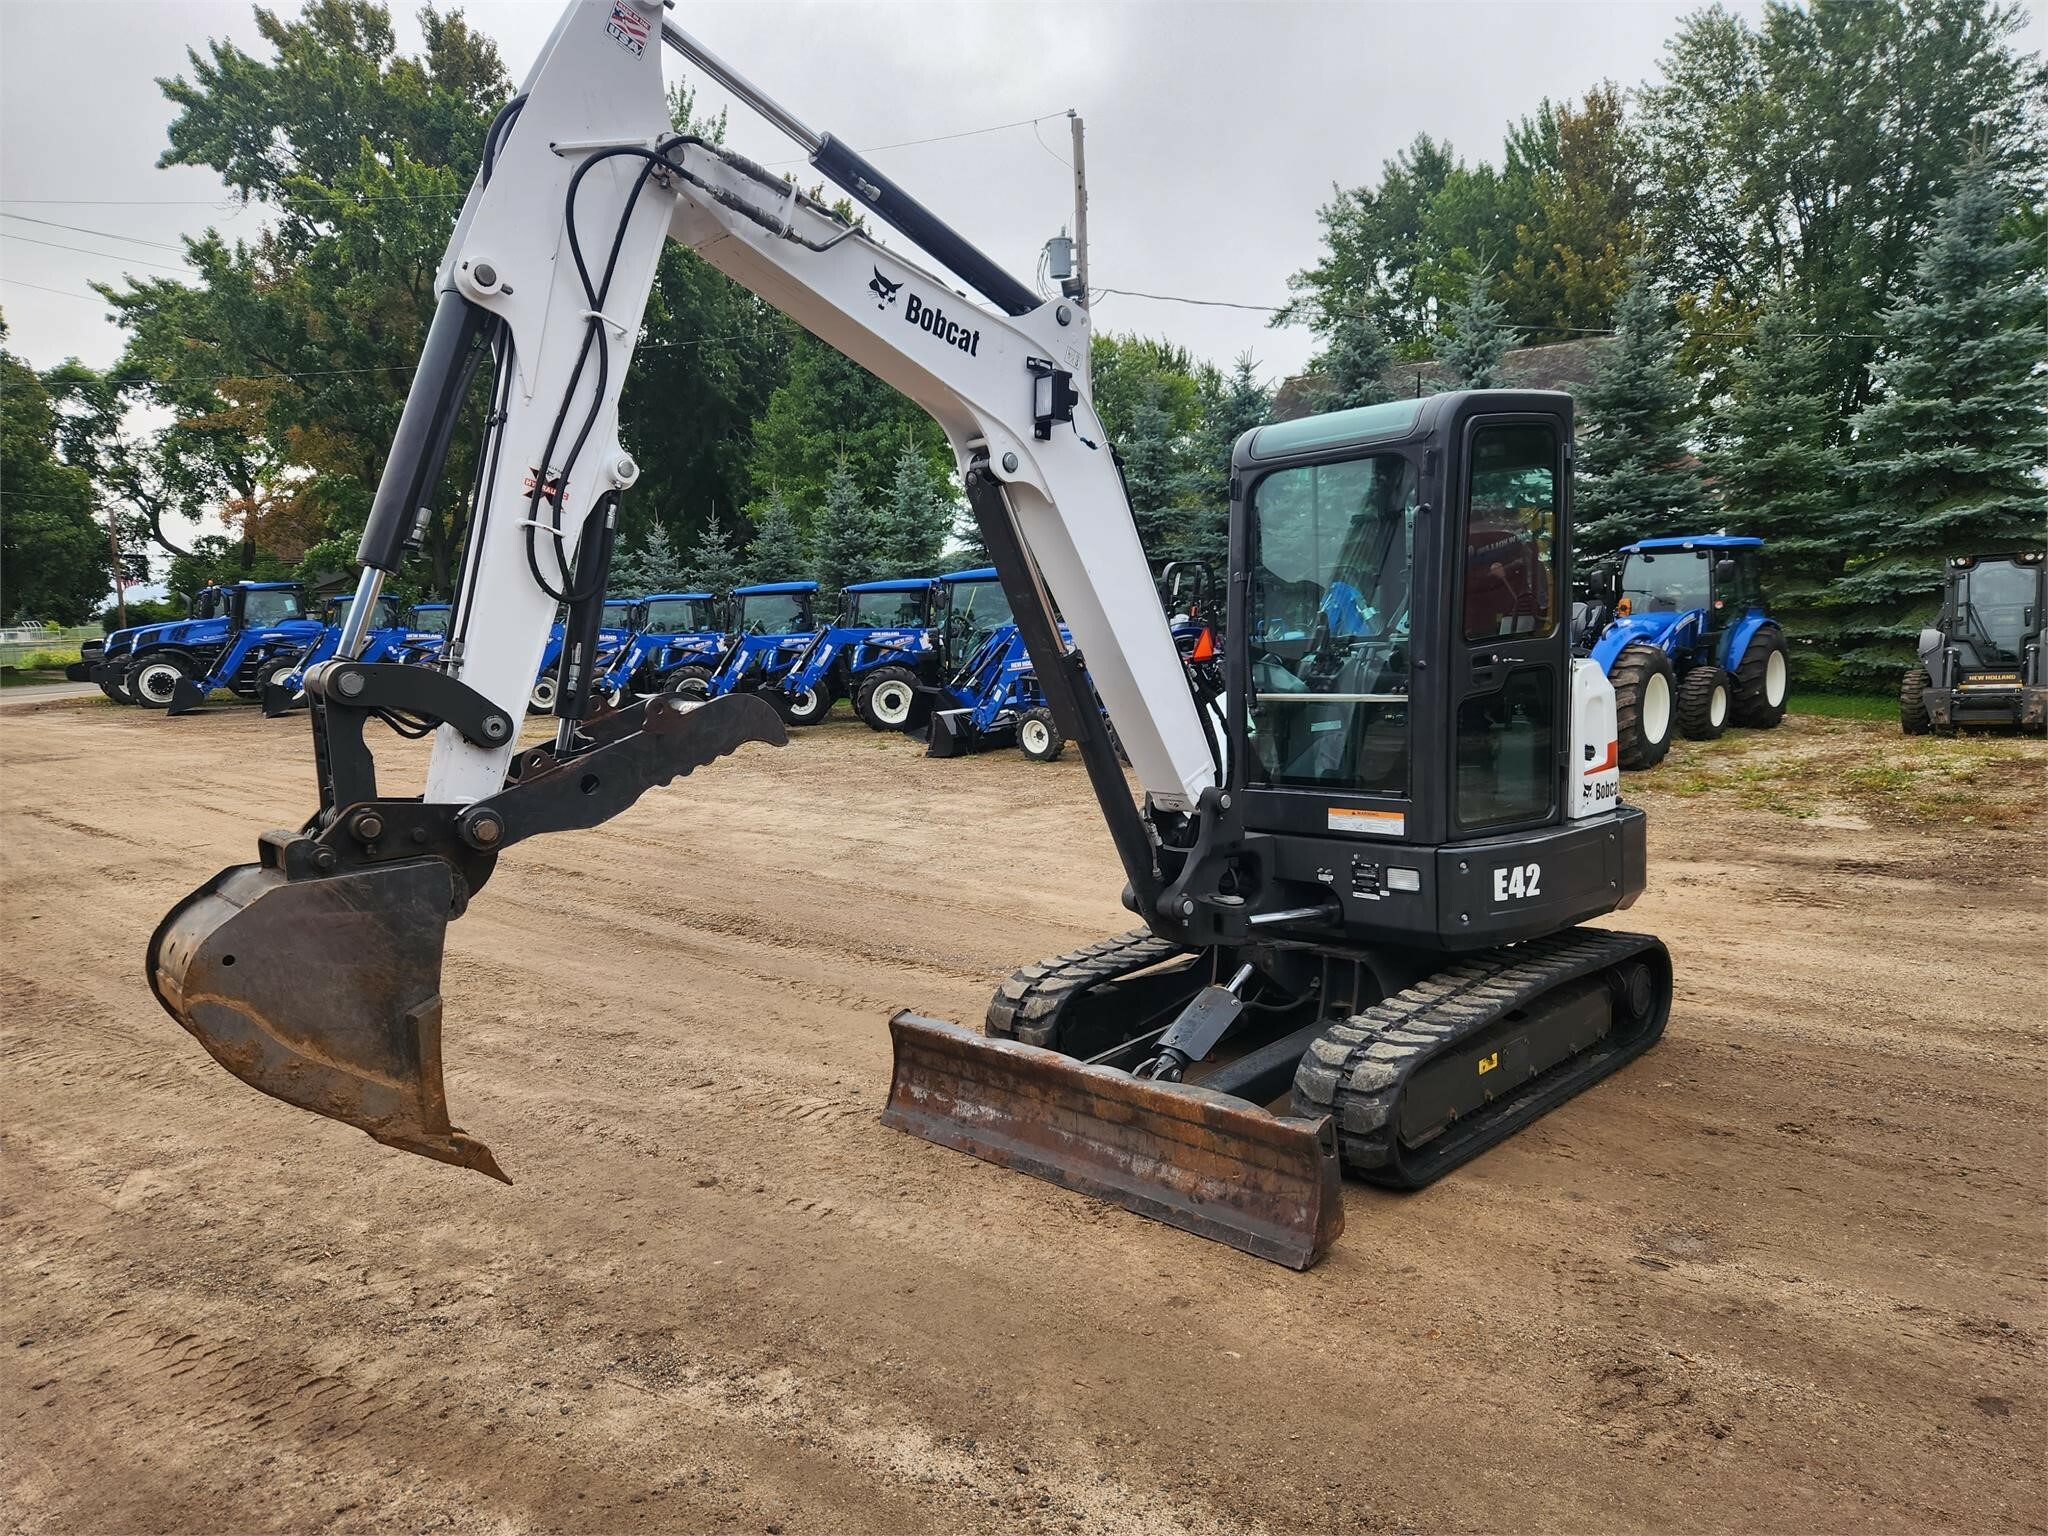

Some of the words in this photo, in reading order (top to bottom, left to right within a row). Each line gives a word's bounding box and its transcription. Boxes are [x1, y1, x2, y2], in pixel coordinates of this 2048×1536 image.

[617, 2, 633, 16] MADE
[640, 18, 650, 28] THE
[608, 24, 642, 54] USA
[905, 293, 980, 357] Bobcat
[1493, 863, 1541, 902] E42
